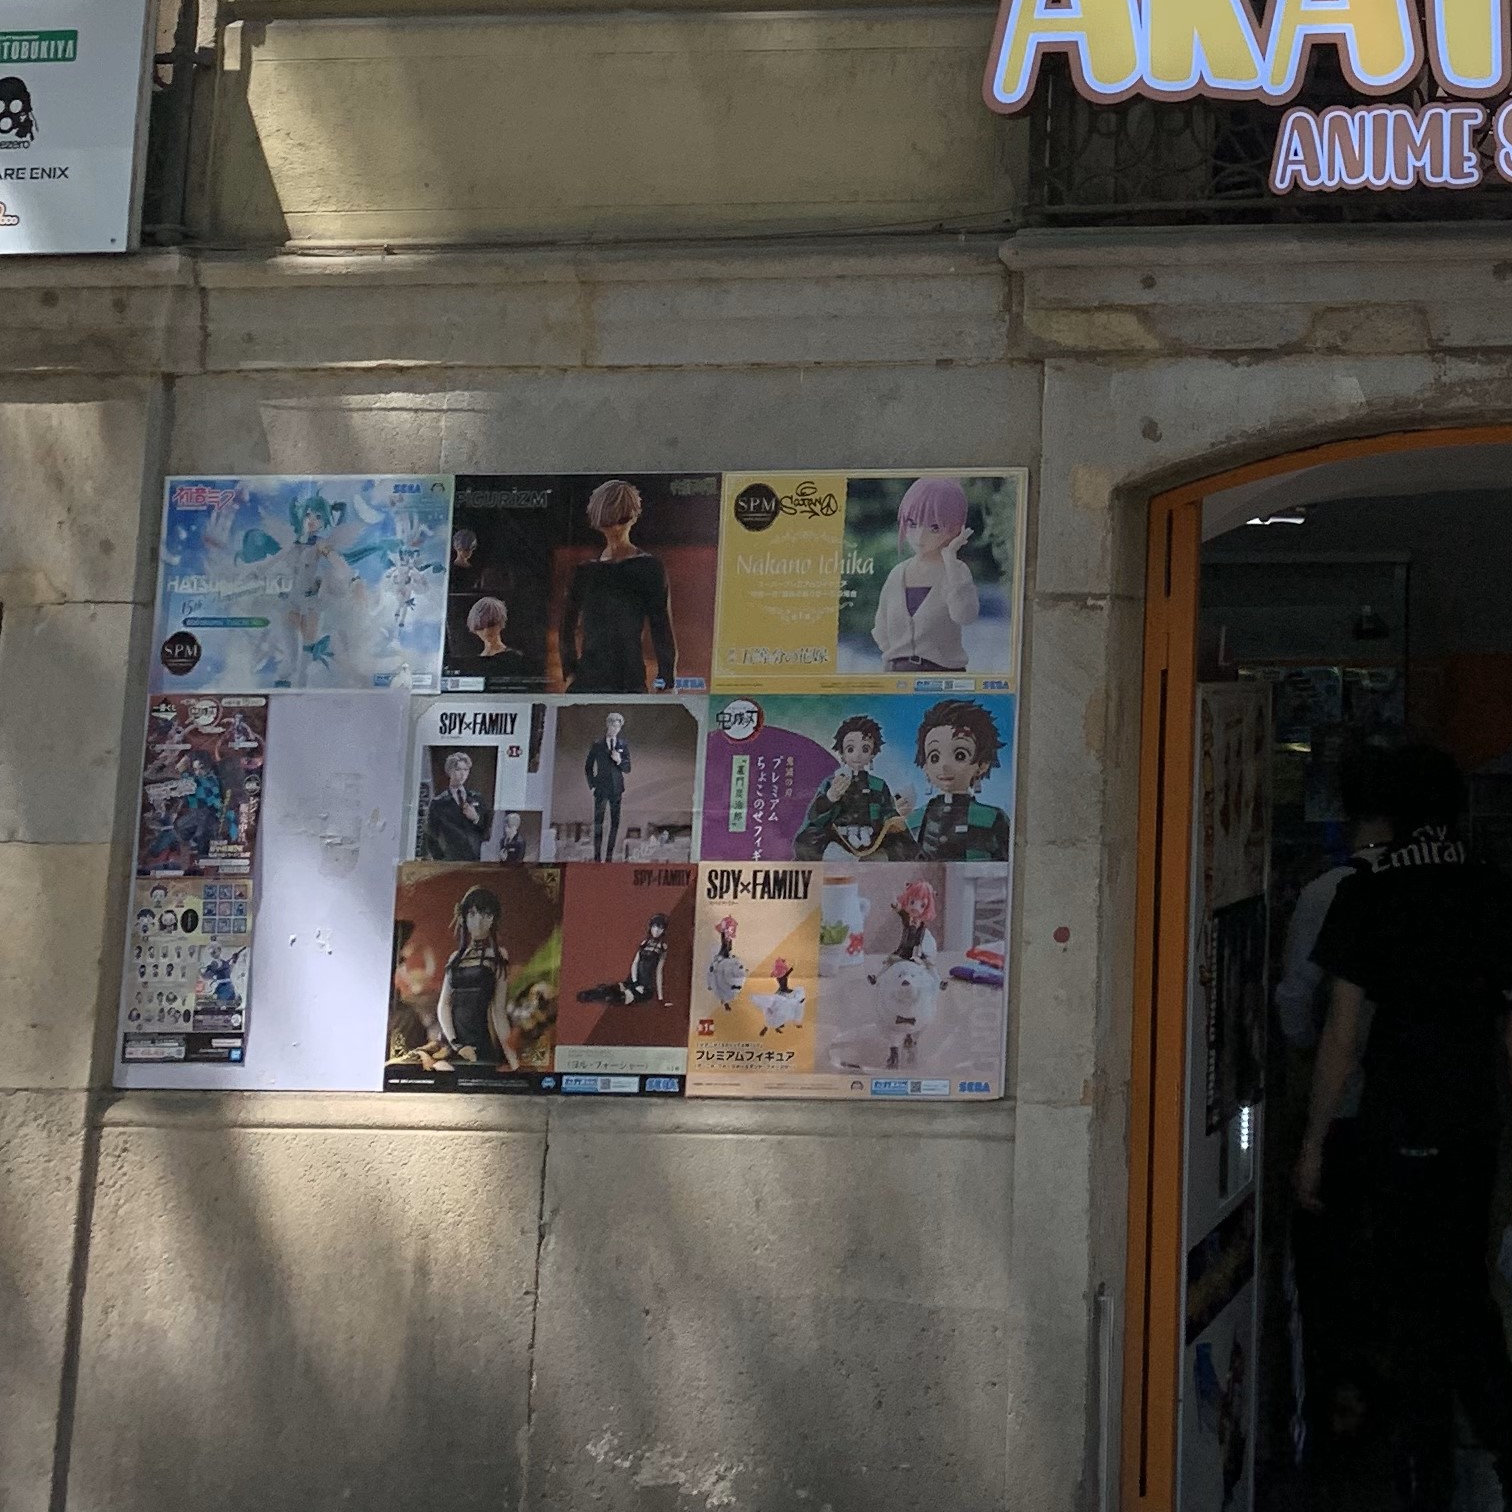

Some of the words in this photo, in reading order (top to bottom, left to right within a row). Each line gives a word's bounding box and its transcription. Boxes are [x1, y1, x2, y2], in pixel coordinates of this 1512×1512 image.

[1274, 107, 1484, 194] ANIME
[29, 166, 70, 180] ENIX
[393, 483, 422, 494] SEGA
[737, 496, 777, 513] SPM
[736, 551, 812, 576] Nakano
[818, 550, 875, 576] Ichika
[164, 644, 199, 657] SPM
[768, 755, 784, 822] プレミアム
[695, 1050, 796, 1062] プレミアムフィギュア
[958, 1081, 992, 1094] SEGA
